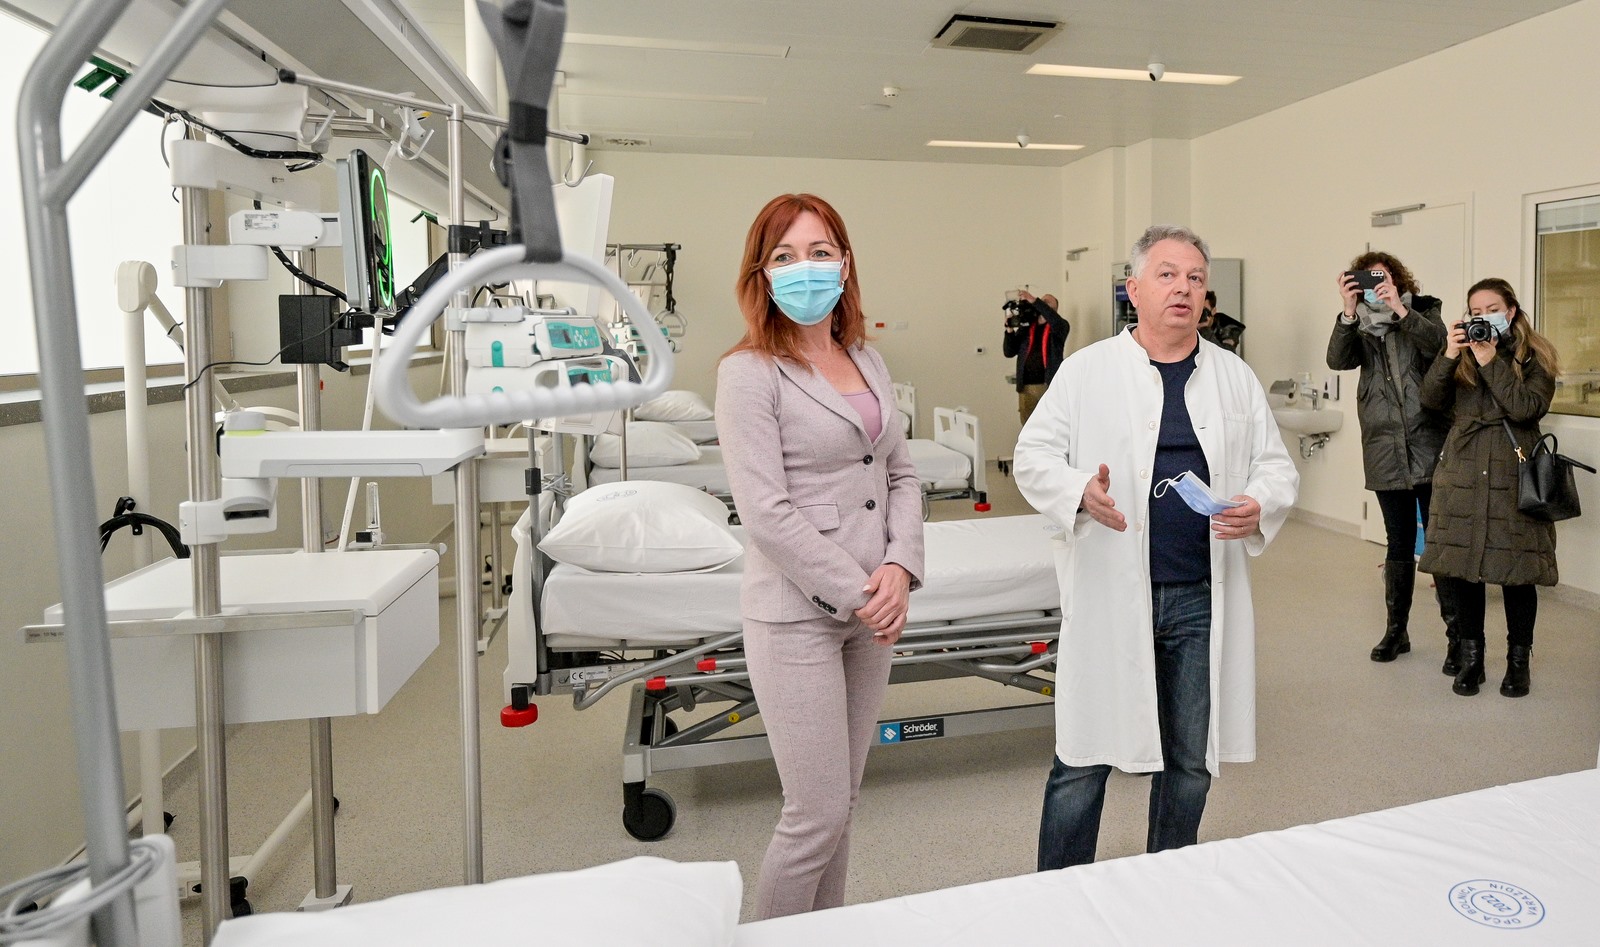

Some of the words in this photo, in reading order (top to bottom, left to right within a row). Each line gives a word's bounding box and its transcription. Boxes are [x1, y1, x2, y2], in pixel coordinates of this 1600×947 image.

[572, 671, 584, 680] CE
[903, 722, 937, 733] Schröder
[1481, 894, 1512, 912] 2022
